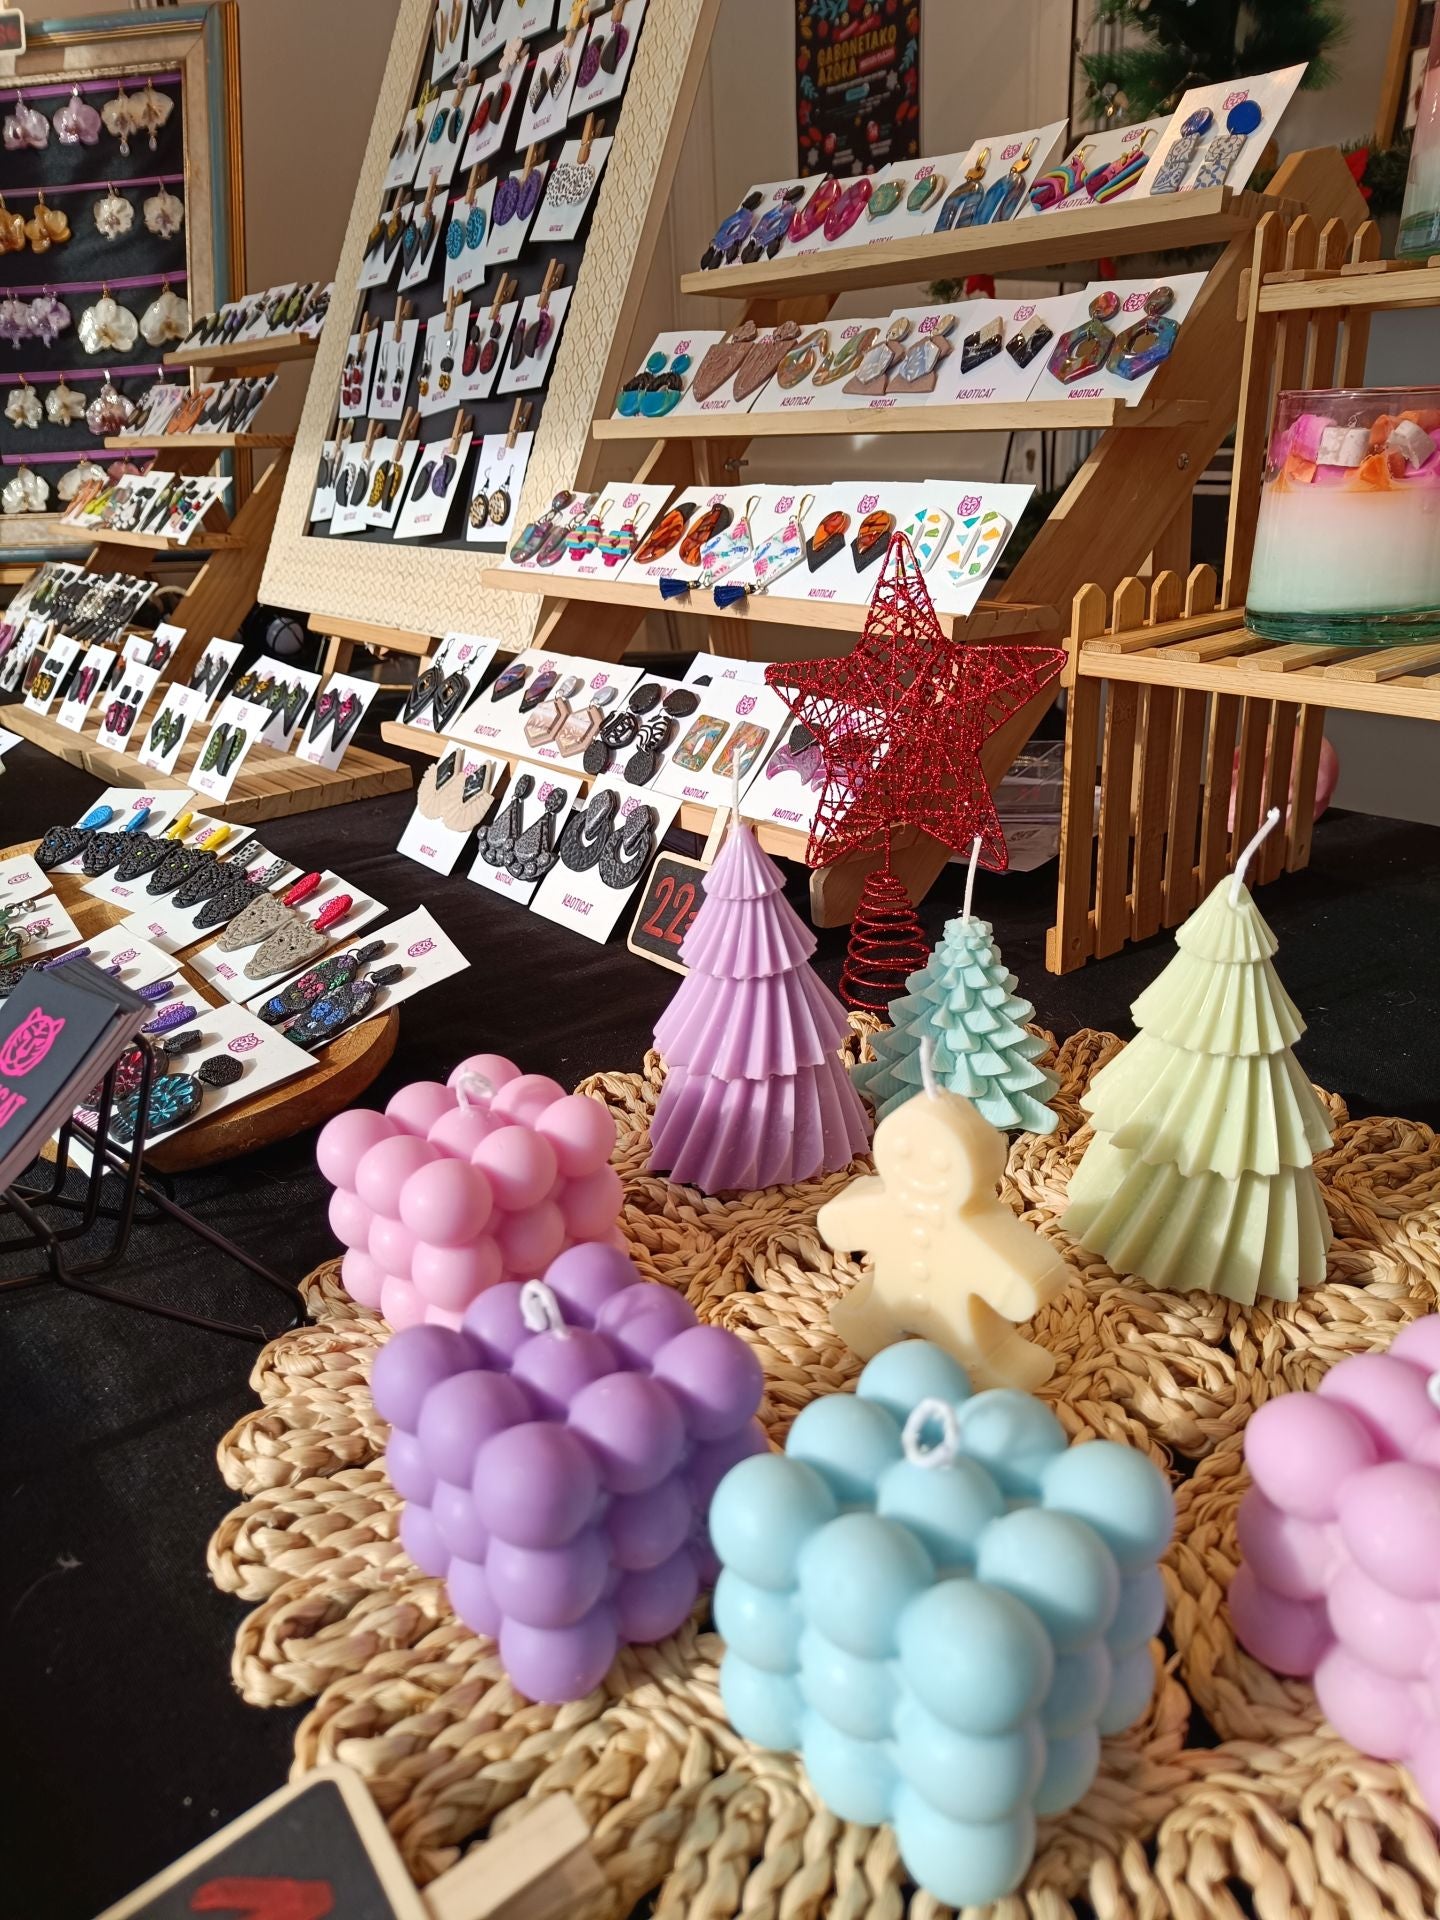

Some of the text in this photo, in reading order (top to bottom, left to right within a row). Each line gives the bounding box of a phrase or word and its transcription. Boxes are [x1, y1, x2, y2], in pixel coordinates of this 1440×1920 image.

[817, 56, 857, 87] AZOKA
[956, 388, 996, 400] KAOTICAT
[1068, 388, 1104, 399] KAOTICAT
[780, 395, 815, 407] KAOTICAT
[645, 566, 678, 578] KAOTICAT
[808, 588, 837, 600] KAOTICAT
[474, 724, 502, 738] KAOTICAT
[682, 785, 709, 801] KAOTICAT
[772, 807, 803, 823] KAOTICAT
[561, 893, 594, 916] KAOTICAT
